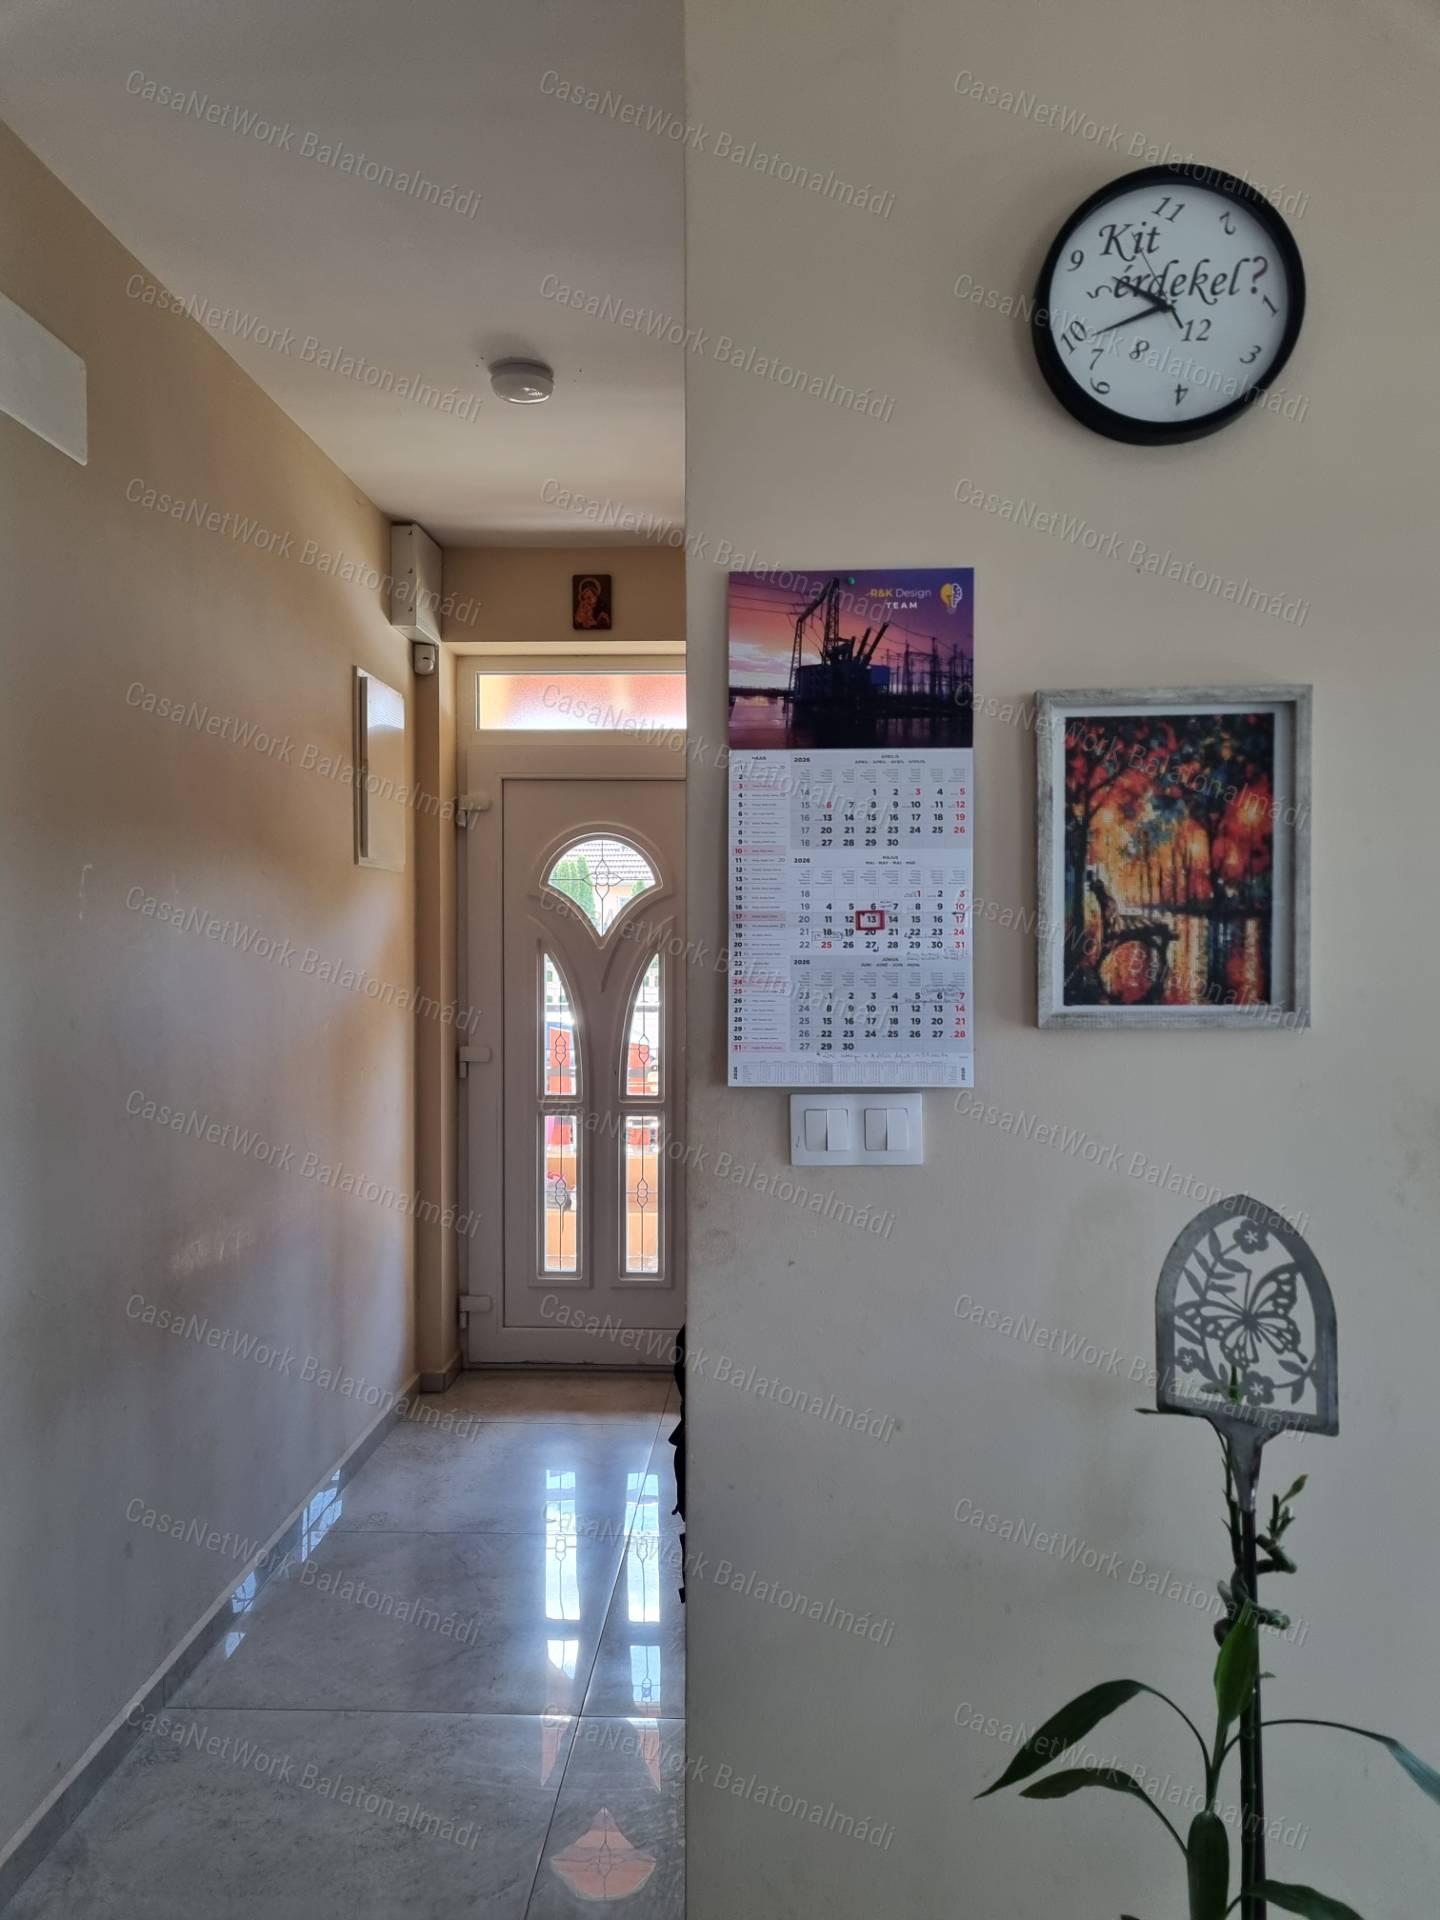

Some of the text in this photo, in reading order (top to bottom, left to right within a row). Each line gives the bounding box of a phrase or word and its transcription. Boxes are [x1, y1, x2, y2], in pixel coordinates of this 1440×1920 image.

[1151, 197, 1186, 223] 11
[1098, 221, 1161, 262] Kit
[1067, 249, 1084, 272] 9
[1113, 256, 1268, 305] érdekel?
[1181, 319, 1211, 341] 12
[1060, 320, 1087, 354] 10
[1129, 340, 1150, 360] 8
[1239, 344, 1262, 365] 3
[1089, 348, 1104, 371] 7
[1174, 383, 1188, 406] 4
[870, 588, 932, 599] R&K Design
[872, 788, 966, 796] 1 2 3 4 5
[870, 801, 966, 809] 8 9 10 11 12
[820, 826, 966, 834] 20 21 22 23 24 25 26
[820, 839, 899, 847] 27 28 29 30
[916, 890, 921, 898] 1
[937, 890, 944, 898] 2
[844, 928, 854, 936] 19
[888, 928, 899, 936] 21
[909, 928, 921, 936] 22
[931, 928, 944, 936] 23
[953, 928, 966, 936] 24
[820, 941, 966, 949] 25 26 27 28 29 30 31
[914, 992, 921, 1000] 5
[820, 1030, 966, 1038] 22 23 24 26 27 28
[820, 1043, 854, 1051] 29 30
